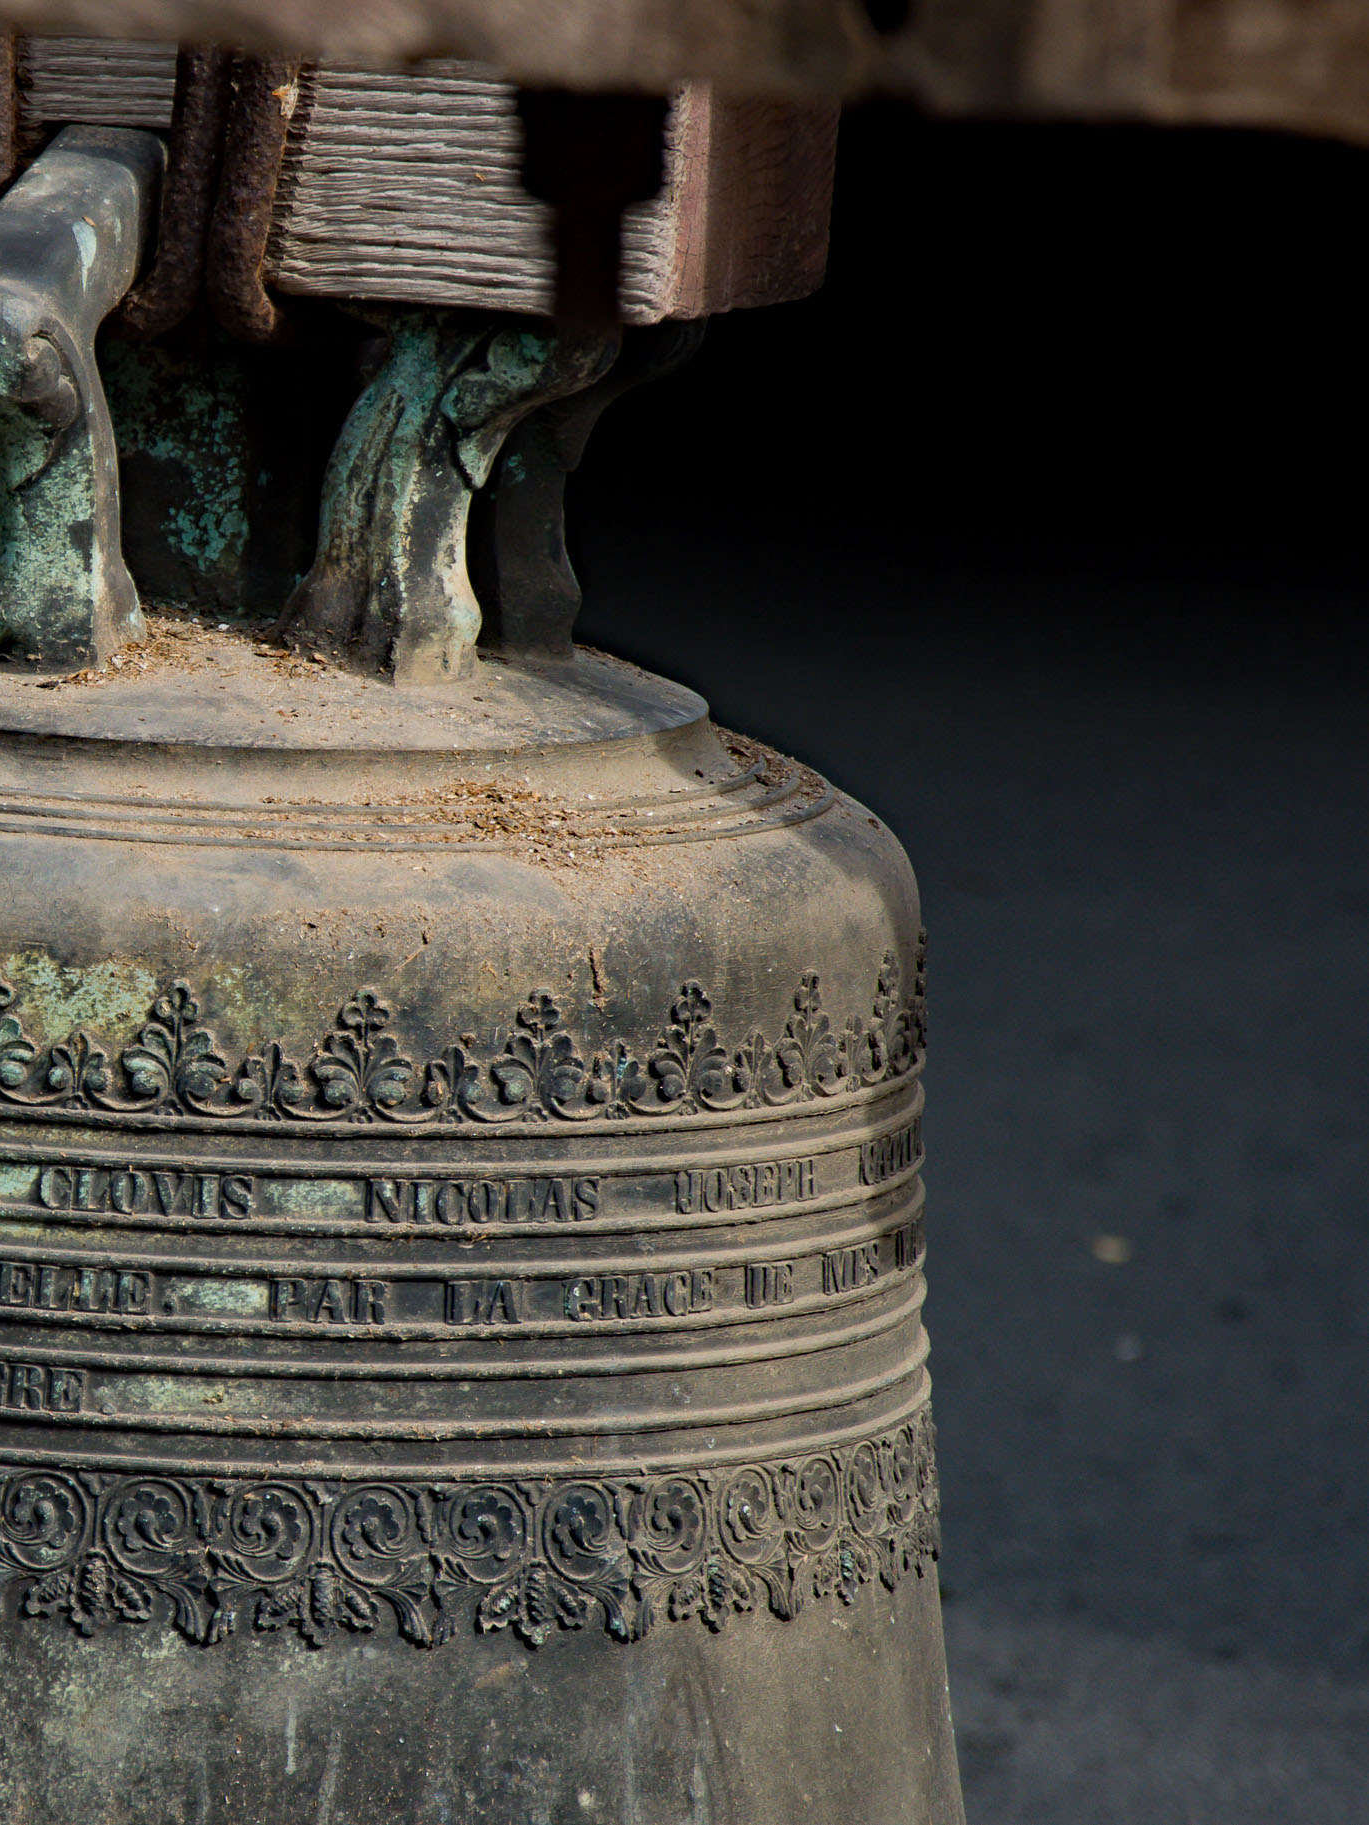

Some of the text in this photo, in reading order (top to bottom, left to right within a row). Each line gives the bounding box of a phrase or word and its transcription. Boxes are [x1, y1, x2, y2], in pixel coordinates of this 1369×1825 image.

[39, 1166, 255, 1220] CLOVIS
[365, 1177, 600, 1225] NICOLAS
[674, 1158, 819, 1214] JOSEPH
[270, 1277, 388, 1325] PAR
[444, 1280, 522, 1325] LA
[563, 1266, 715, 1322] GRACE
